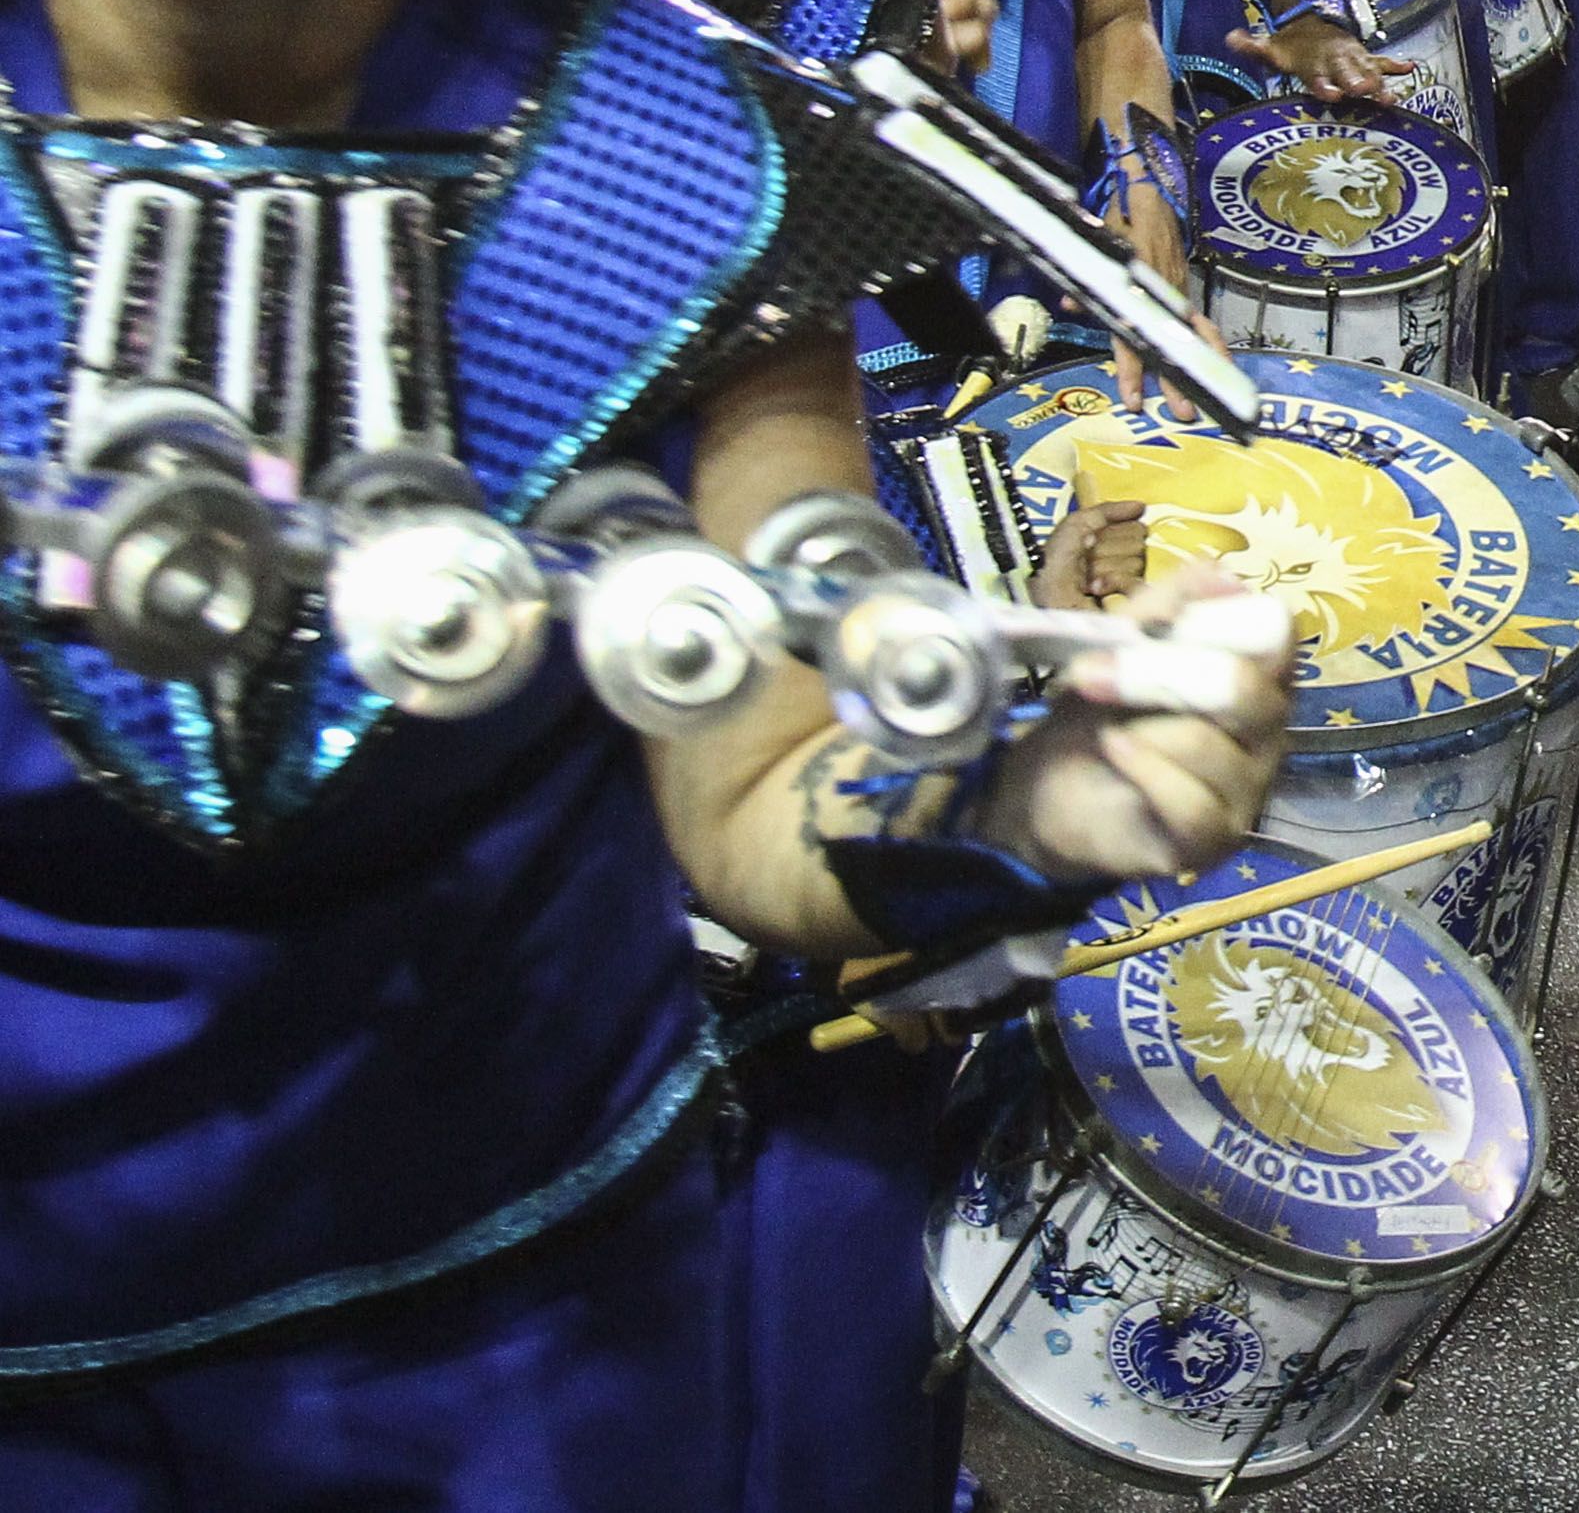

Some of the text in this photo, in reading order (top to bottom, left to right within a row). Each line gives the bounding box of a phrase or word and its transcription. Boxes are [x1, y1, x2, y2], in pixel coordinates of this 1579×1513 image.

[1405, 88, 1438, 110] ERIA
[1243, 126, 1443, 189] BATERIA SHOW
[1215, 176, 1434, 252] MOCIDADE AZUL
[1355, 530, 1518, 670] BATERIA
[1124, 942, 1185, 1068] BATER
[1212, 1125, 1447, 1202] MOCIDADE
[1403, 996, 1469, 1101] AZUL
[1112, 1317, 1234, 1409] MOCIDADE AZUL
[1241, 1332, 1261, 1373] SHOW
